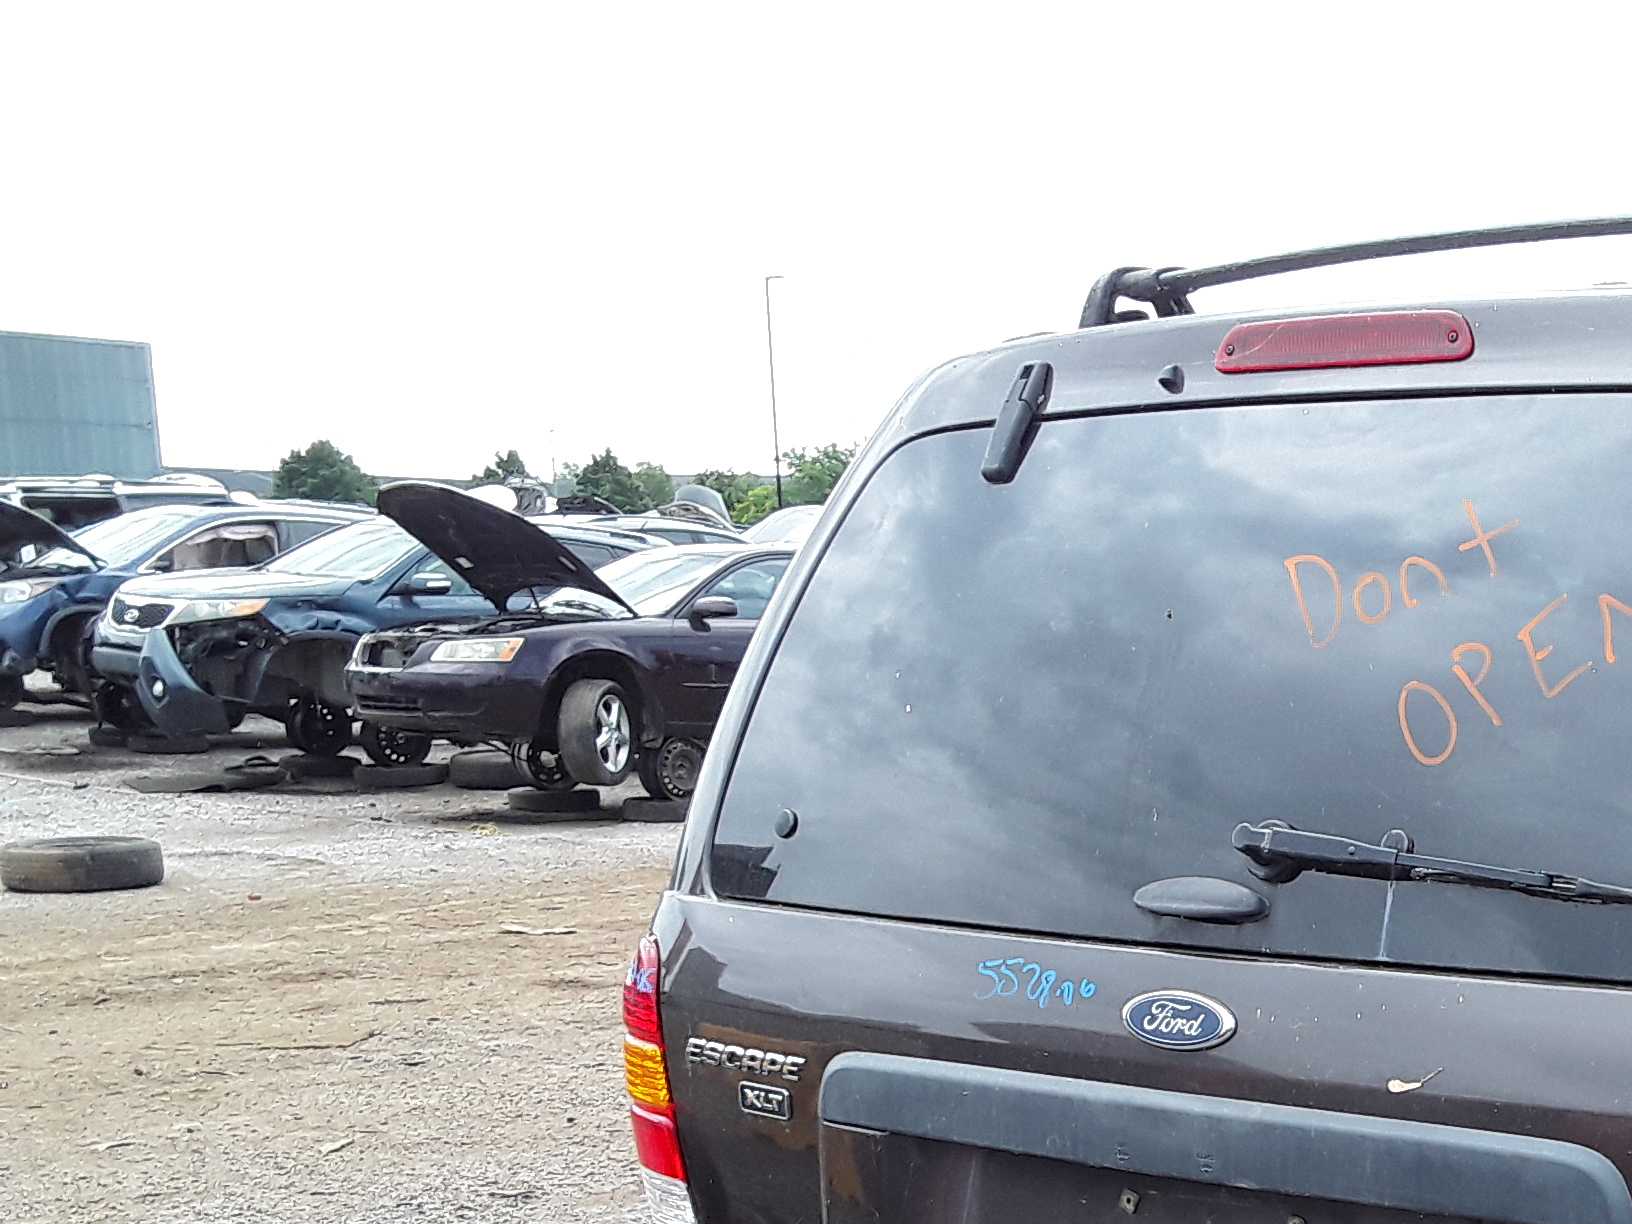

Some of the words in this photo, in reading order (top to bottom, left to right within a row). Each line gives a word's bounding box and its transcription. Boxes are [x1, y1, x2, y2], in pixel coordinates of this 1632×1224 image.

[1143, 1000, 1206, 1036] Ford
[685, 1037, 808, 1081] ESCAPE
[742, 1088, 784, 1112] XLT
